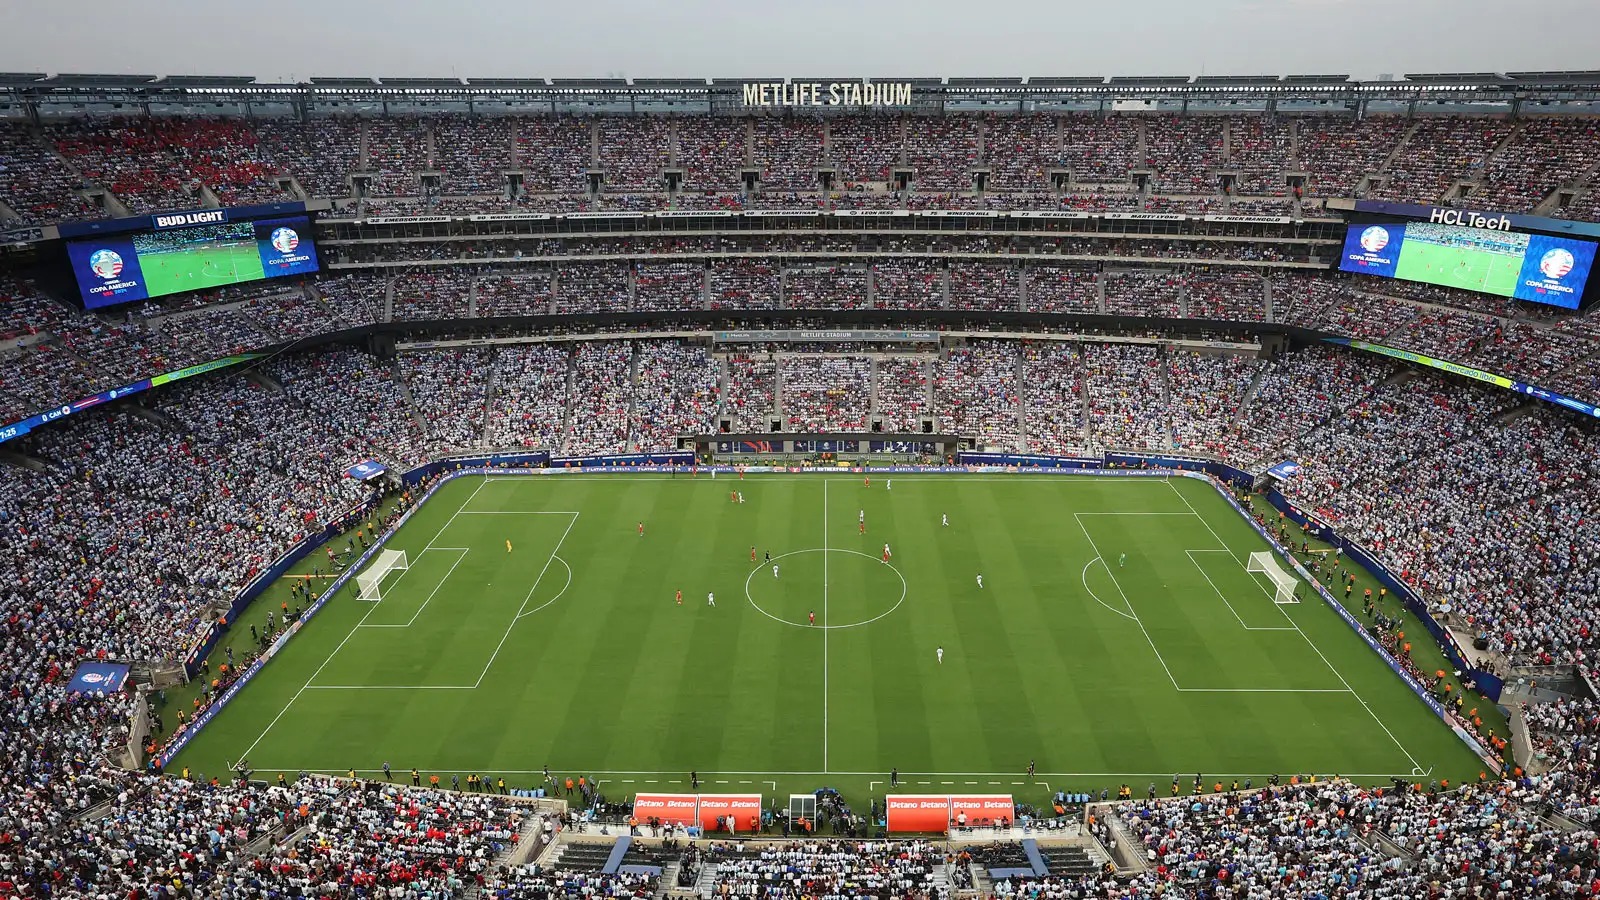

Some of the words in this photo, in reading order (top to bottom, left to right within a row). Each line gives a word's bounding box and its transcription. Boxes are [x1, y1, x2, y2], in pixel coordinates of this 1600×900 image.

[743, 83, 822, 106] METLIFE
[829, 83, 912, 106] STADIUM
[157, 215, 187, 227] BUD
[187, 211, 224, 225] LIGHT
[1430, 208, 1511, 231] HCLTech
[269, 257, 285, 266] COPA
[284, 255, 310, 264] AMERICA
[1364, 256, 1391, 265] AMERICA
[89, 285, 108, 294] COPA
[108, 280, 137, 291] AMERICA
[1525, 280, 1544, 289] COPA
[1543, 282, 1574, 294] AMERICA
[183, 362, 216, 377] mercado
[1445, 363, 1479, 378] mercado
[1479, 370, 1497, 383] libre
[48, 410, 62, 420] CAN
[1361, 629, 1376, 646] LATAM
[1380, 649, 1395, 665] DELTA
[245, 664, 260, 680] DELTA
[1402, 671, 1418, 690] LATAM
[222, 684, 239, 704] LATAM
[1424, 695, 1441, 713] DELTA
[196, 710, 212, 729] DELTA
[168, 735, 188, 757] LATAM
[636, 799, 664, 807] Betano
[667, 799, 695, 808] Betano
[700, 800, 728, 808] Betano
[731, 800, 759, 808] Betano
[890, 801, 918, 809] Betano
[920, 801, 947, 809] Betano
[953, 801, 981, 809] Betano
[983, 801, 1012, 809] Betano
